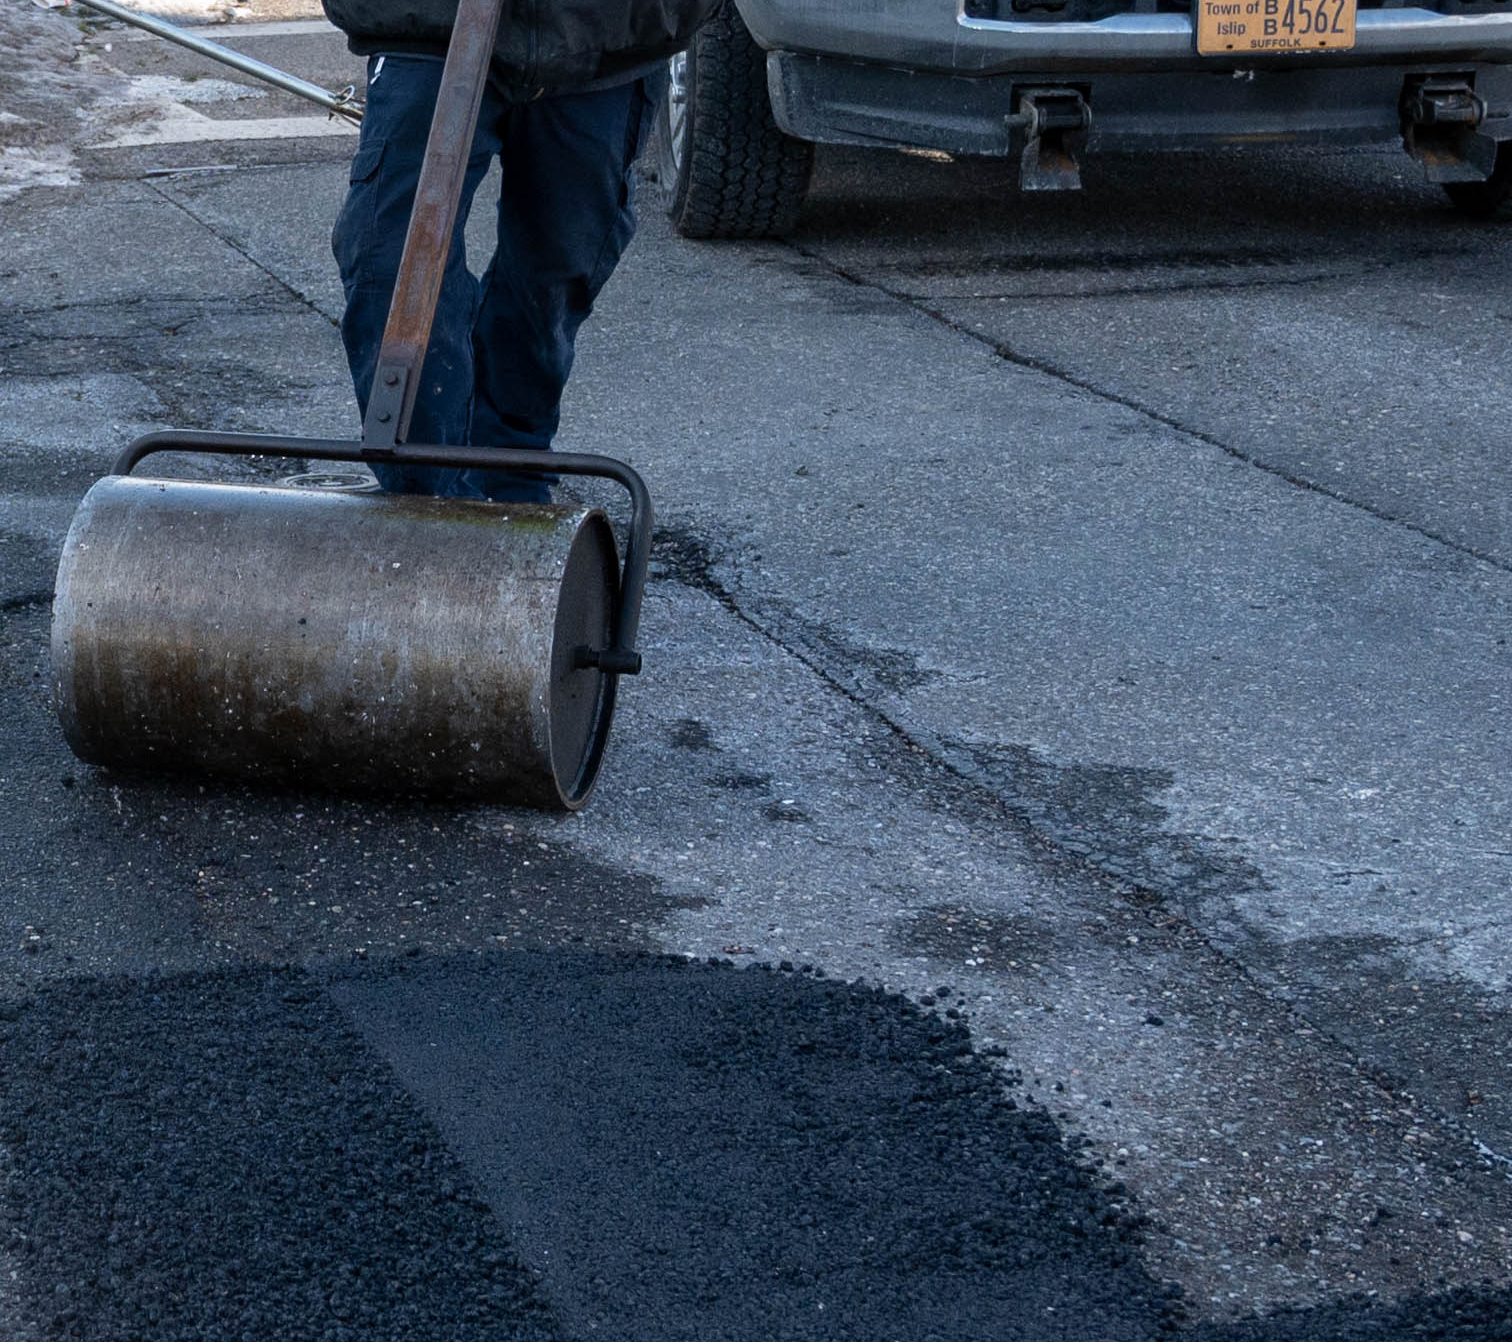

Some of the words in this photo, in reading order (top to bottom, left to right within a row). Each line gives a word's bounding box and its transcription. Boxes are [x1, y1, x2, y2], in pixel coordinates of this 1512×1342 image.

[1205, 2, 1240, 15] Town
[1246, 0, 1260, 14] of
[1217, 21, 1246, 36] Islip
[1250, 38, 1301, 48] SUFFOLK
